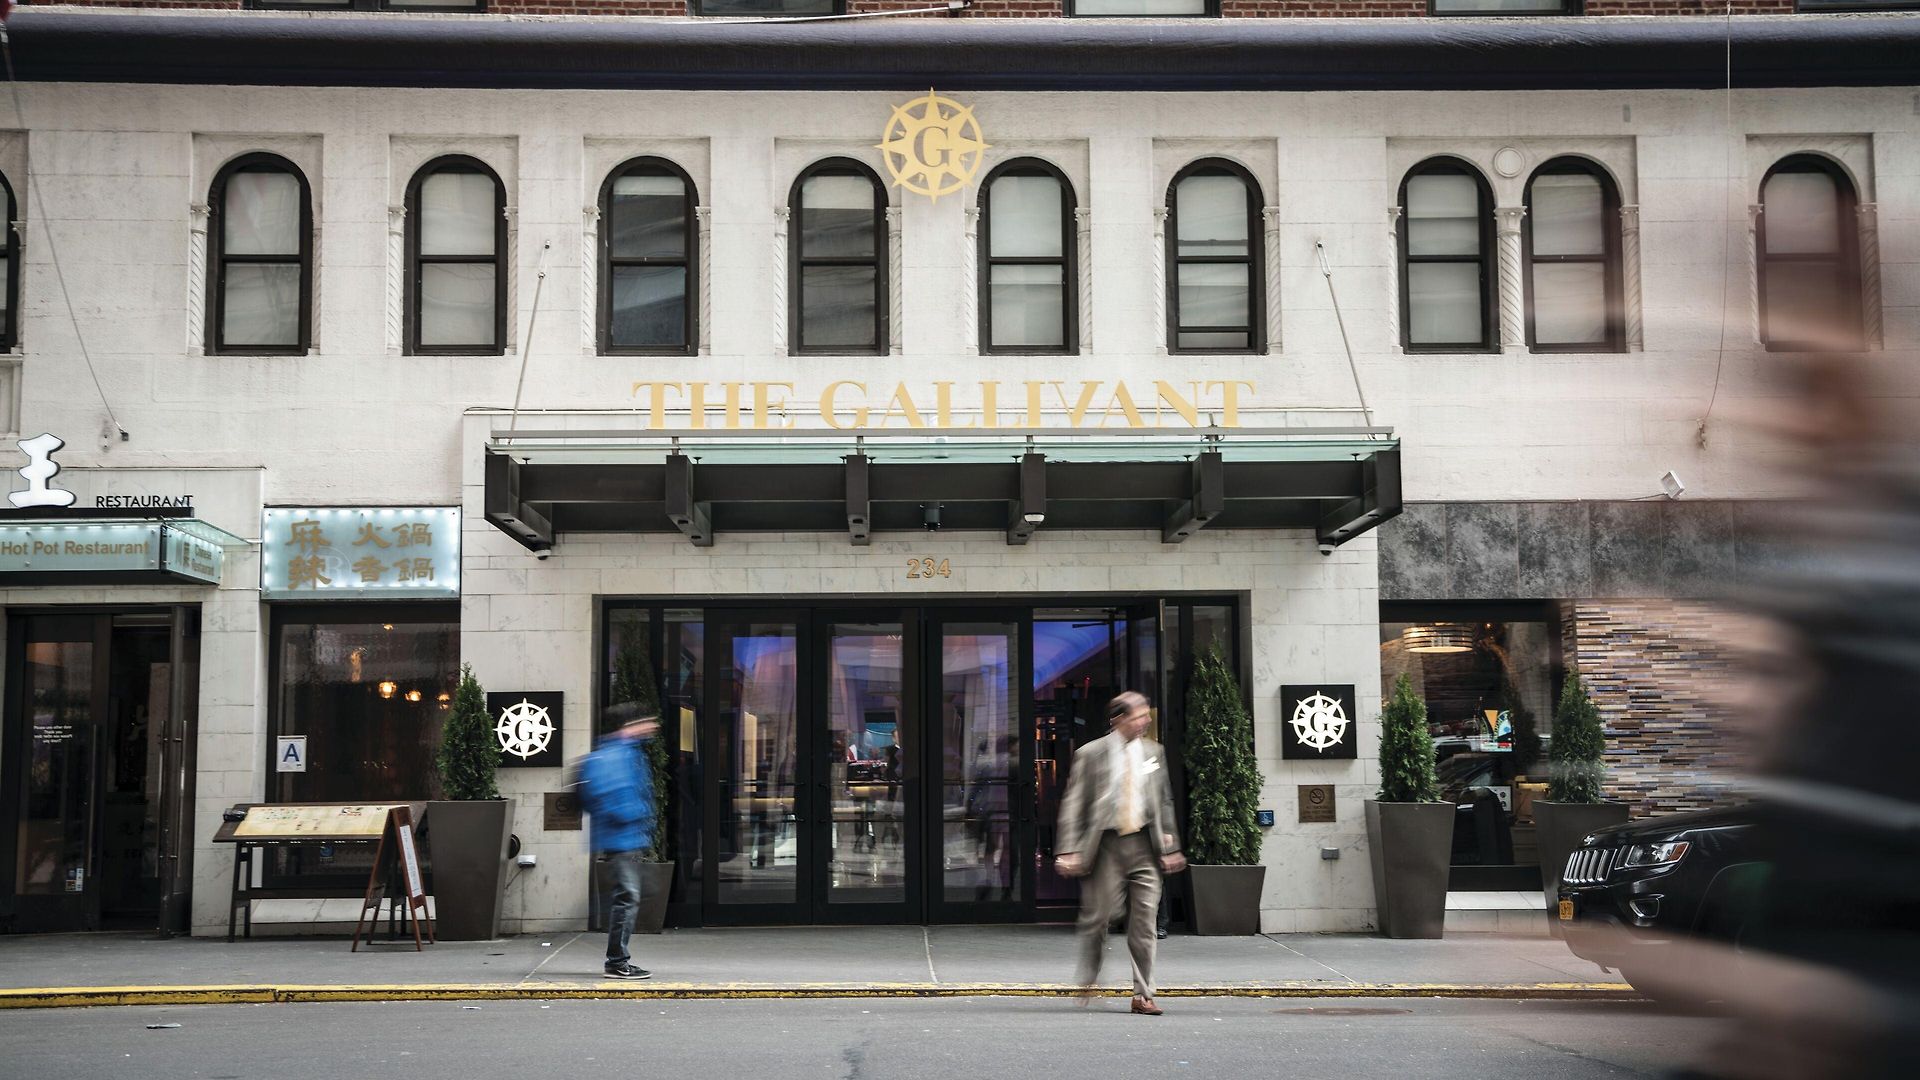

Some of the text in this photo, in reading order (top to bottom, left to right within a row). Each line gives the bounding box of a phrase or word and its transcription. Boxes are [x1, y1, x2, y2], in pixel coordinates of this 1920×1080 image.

[632, 380, 1256, 430] THE GALLIVANT
[96, 495, 194, 508] RESTAURANT
[1, 540, 149, 556] Hot Pot Restaurant
[906, 557, 952, 579] 234
[283, 743, 300, 762] A
